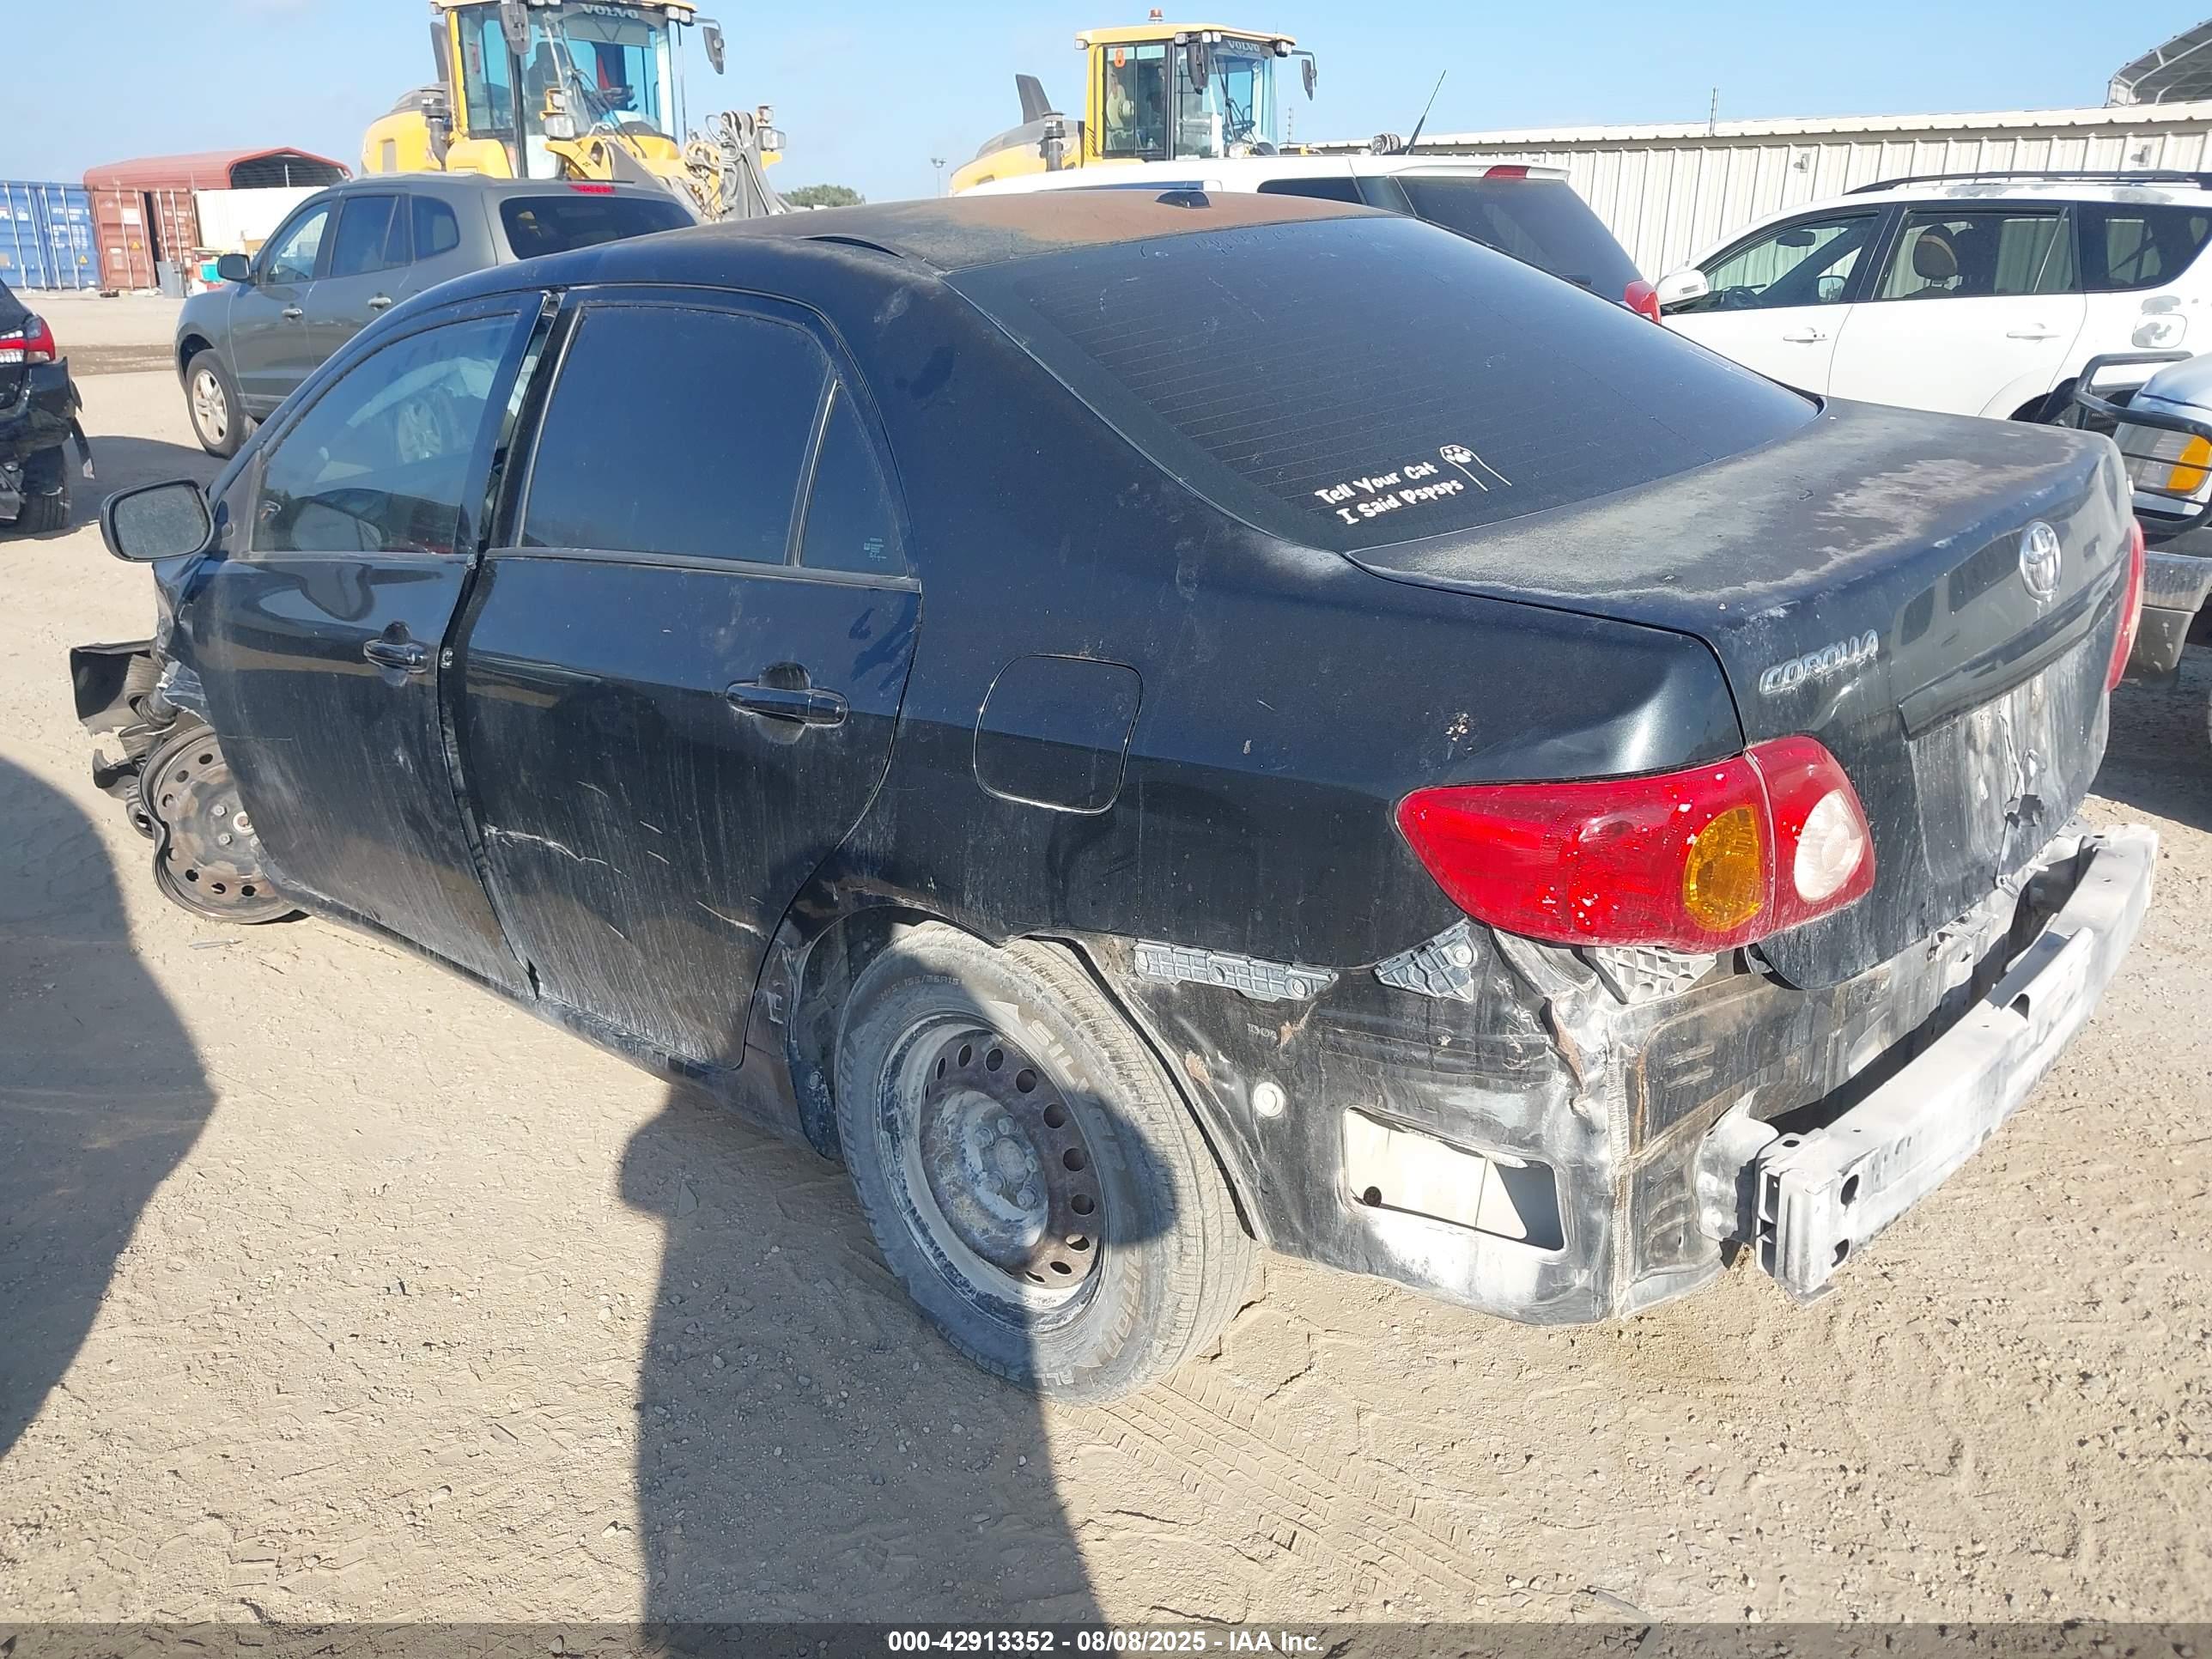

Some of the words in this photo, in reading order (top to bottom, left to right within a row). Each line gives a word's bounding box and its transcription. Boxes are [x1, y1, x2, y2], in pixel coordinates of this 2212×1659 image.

[579, 3, 639, 19] VOLVO
[1227, 40, 1260, 52] VOLVO
[1314, 483, 1357, 505] Tell
[1352, 471, 1402, 495] Your
[1403, 461, 1439, 480] Cat
[1335, 507, 1360, 526] I
[1357, 494, 1402, 519] Said
[1759, 629, 1879, 695] COROLLA
